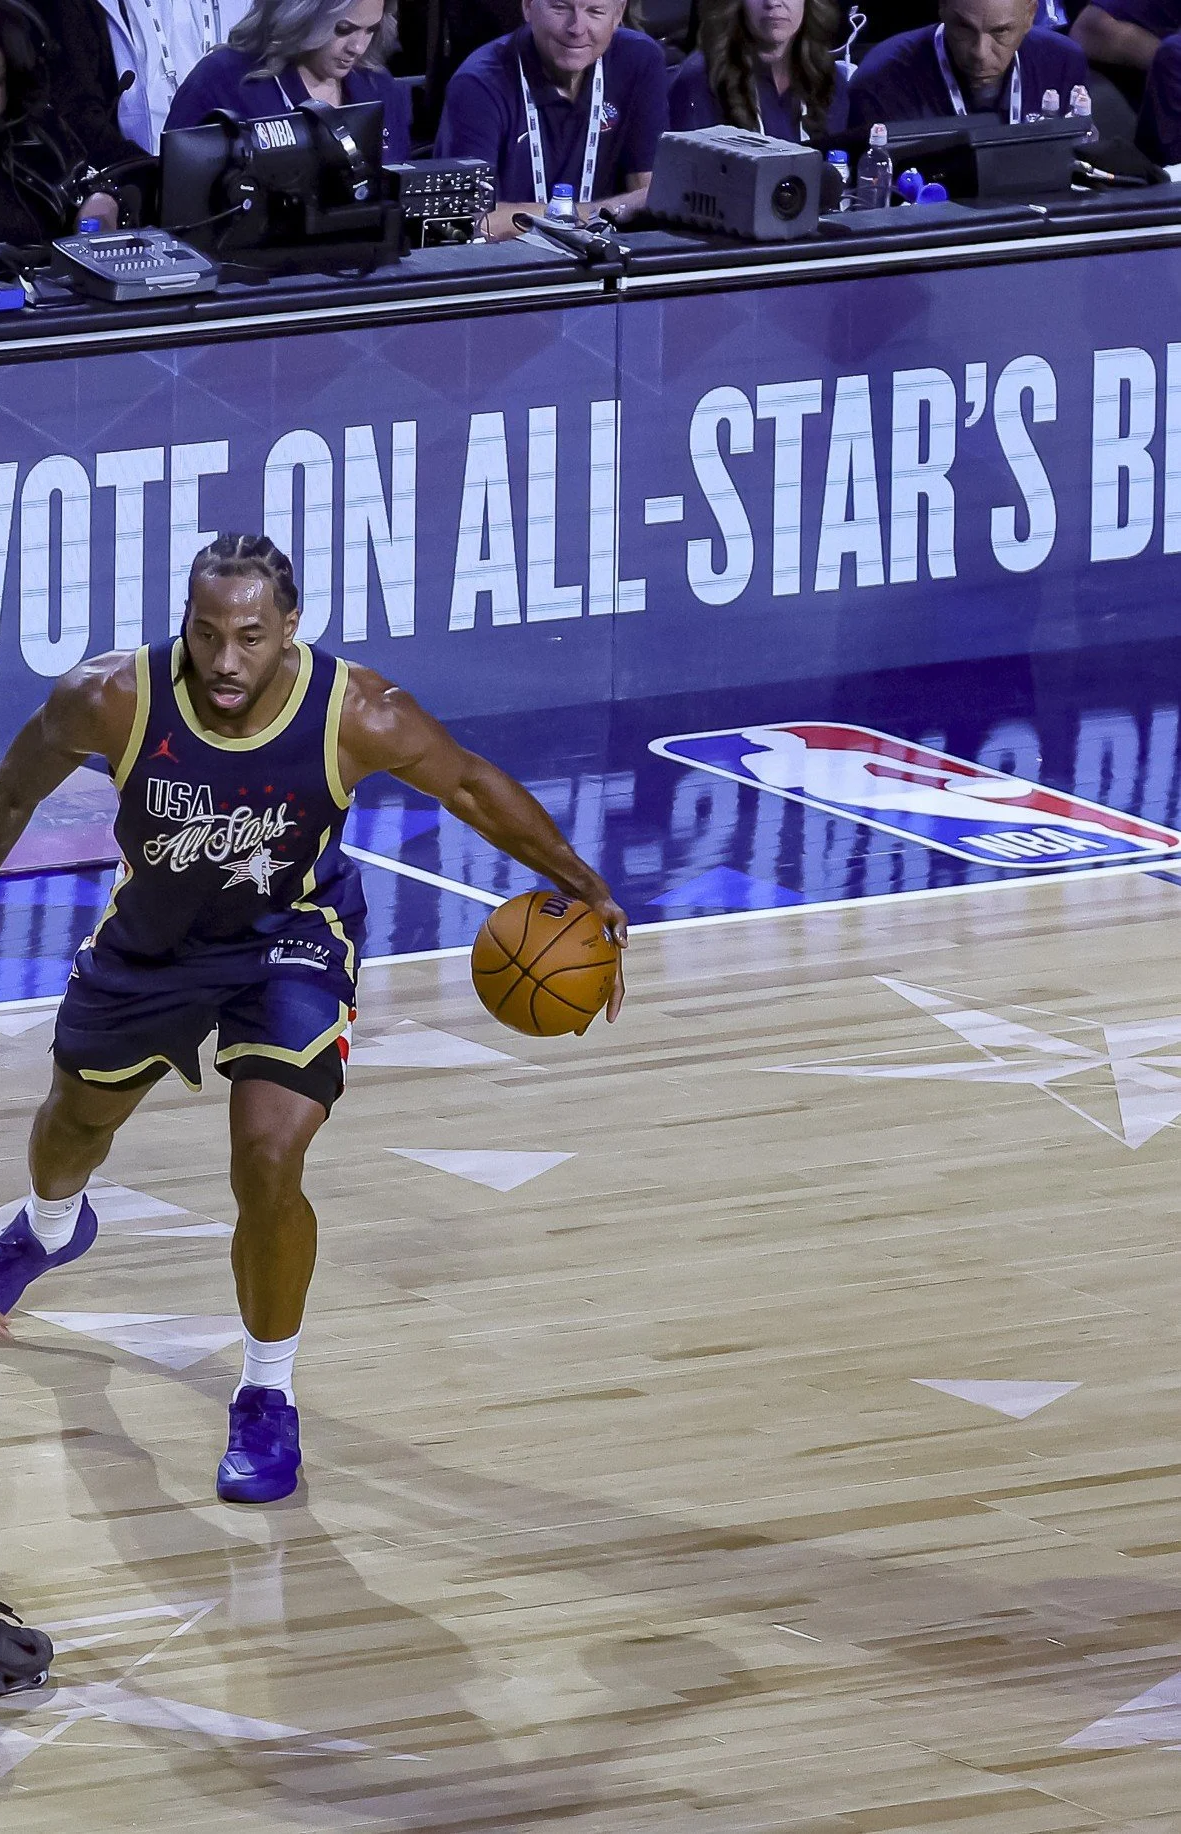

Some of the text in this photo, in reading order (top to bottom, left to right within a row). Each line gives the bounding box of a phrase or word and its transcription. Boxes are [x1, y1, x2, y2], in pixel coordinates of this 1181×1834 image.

[266, 119, 297, 148] NBA
[263, 420, 417, 643] ON
[449, 354, 1057, 632] ALL-STAR'S
[1090, 342, 1181, 562] B
[146, 777, 215, 823] USA
[958, 827, 1109, 860] NBA
